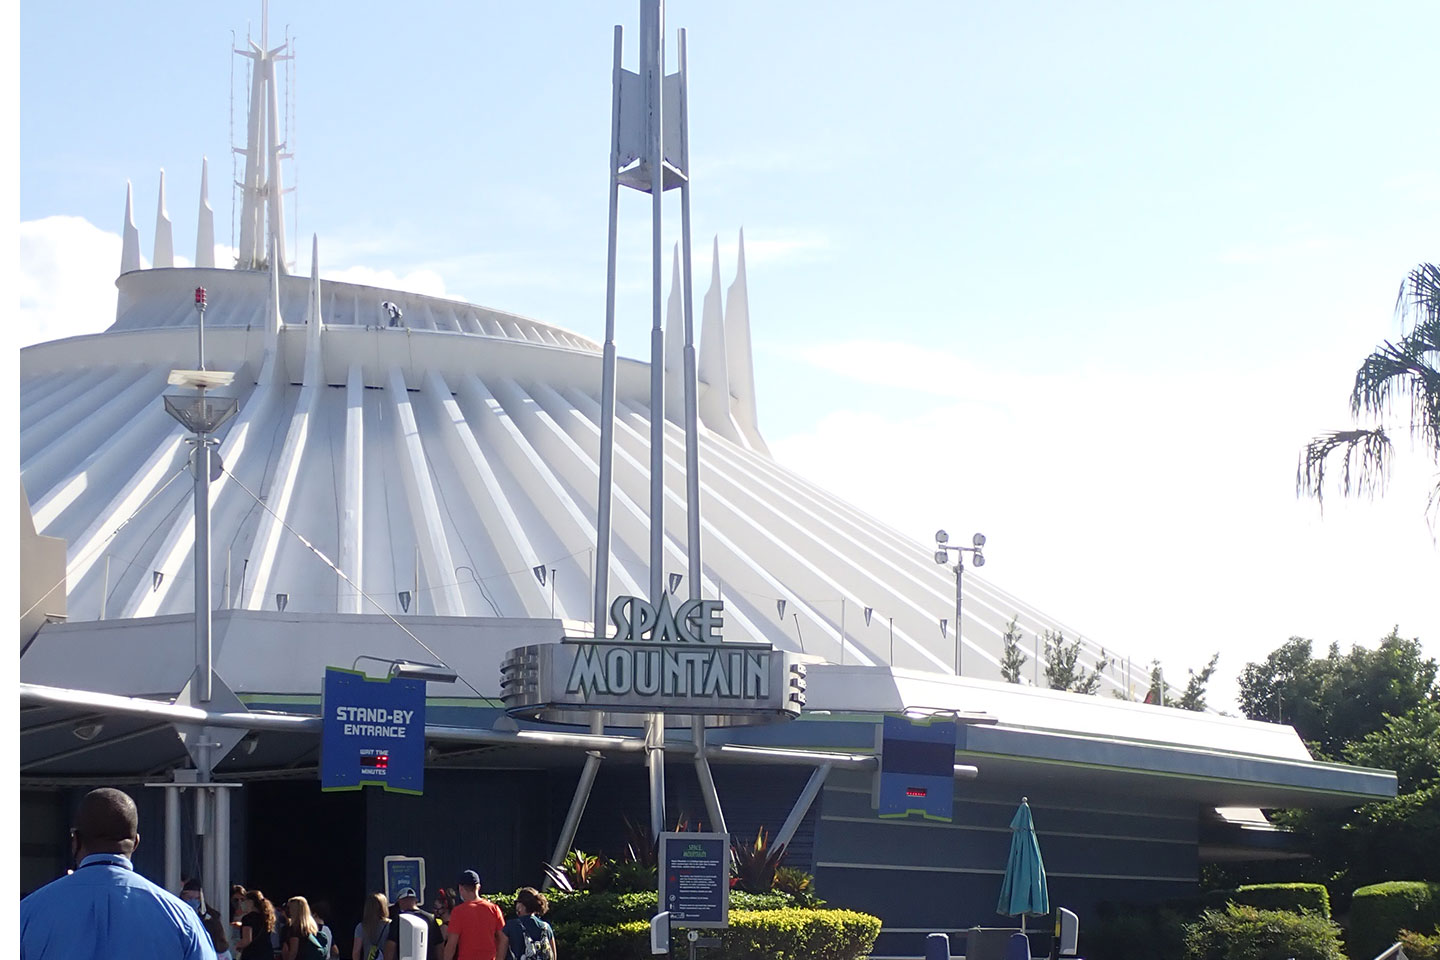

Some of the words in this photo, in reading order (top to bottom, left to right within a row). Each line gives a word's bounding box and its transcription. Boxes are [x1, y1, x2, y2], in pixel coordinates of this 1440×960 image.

[611, 589, 724, 643] SPACE
[565, 645, 771, 702] MOUNTAIN
[336, 706, 414, 725] STAND-BY
[344, 724, 406, 738] ENTRANCE
